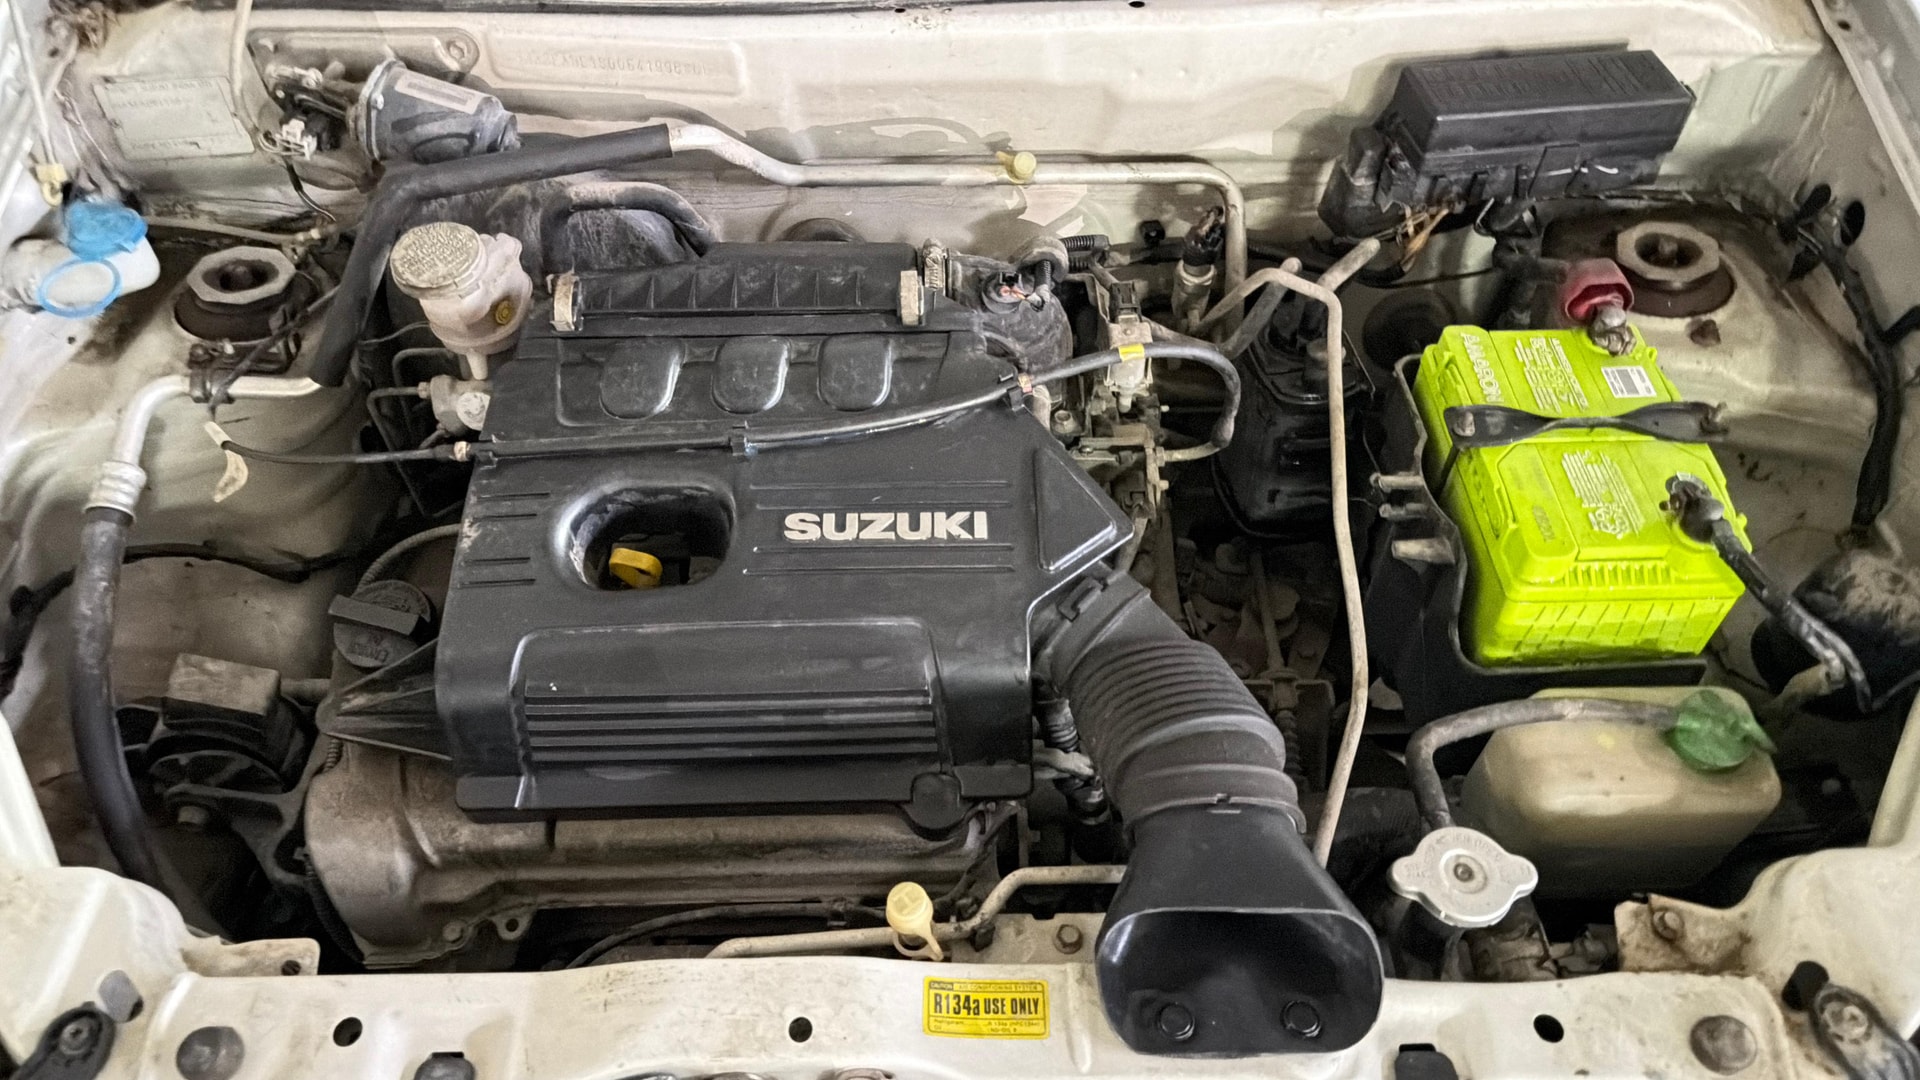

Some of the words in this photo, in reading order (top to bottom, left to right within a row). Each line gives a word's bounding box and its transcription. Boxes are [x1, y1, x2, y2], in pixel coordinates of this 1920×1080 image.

[1461, 331, 1504, 404] AMARON
[783, 511, 988, 541] SUZUKI
[934, 992, 980, 1016] R134a
[984, 997, 1006, 1015] USE
[1010, 997, 1040, 1015] ONLY
